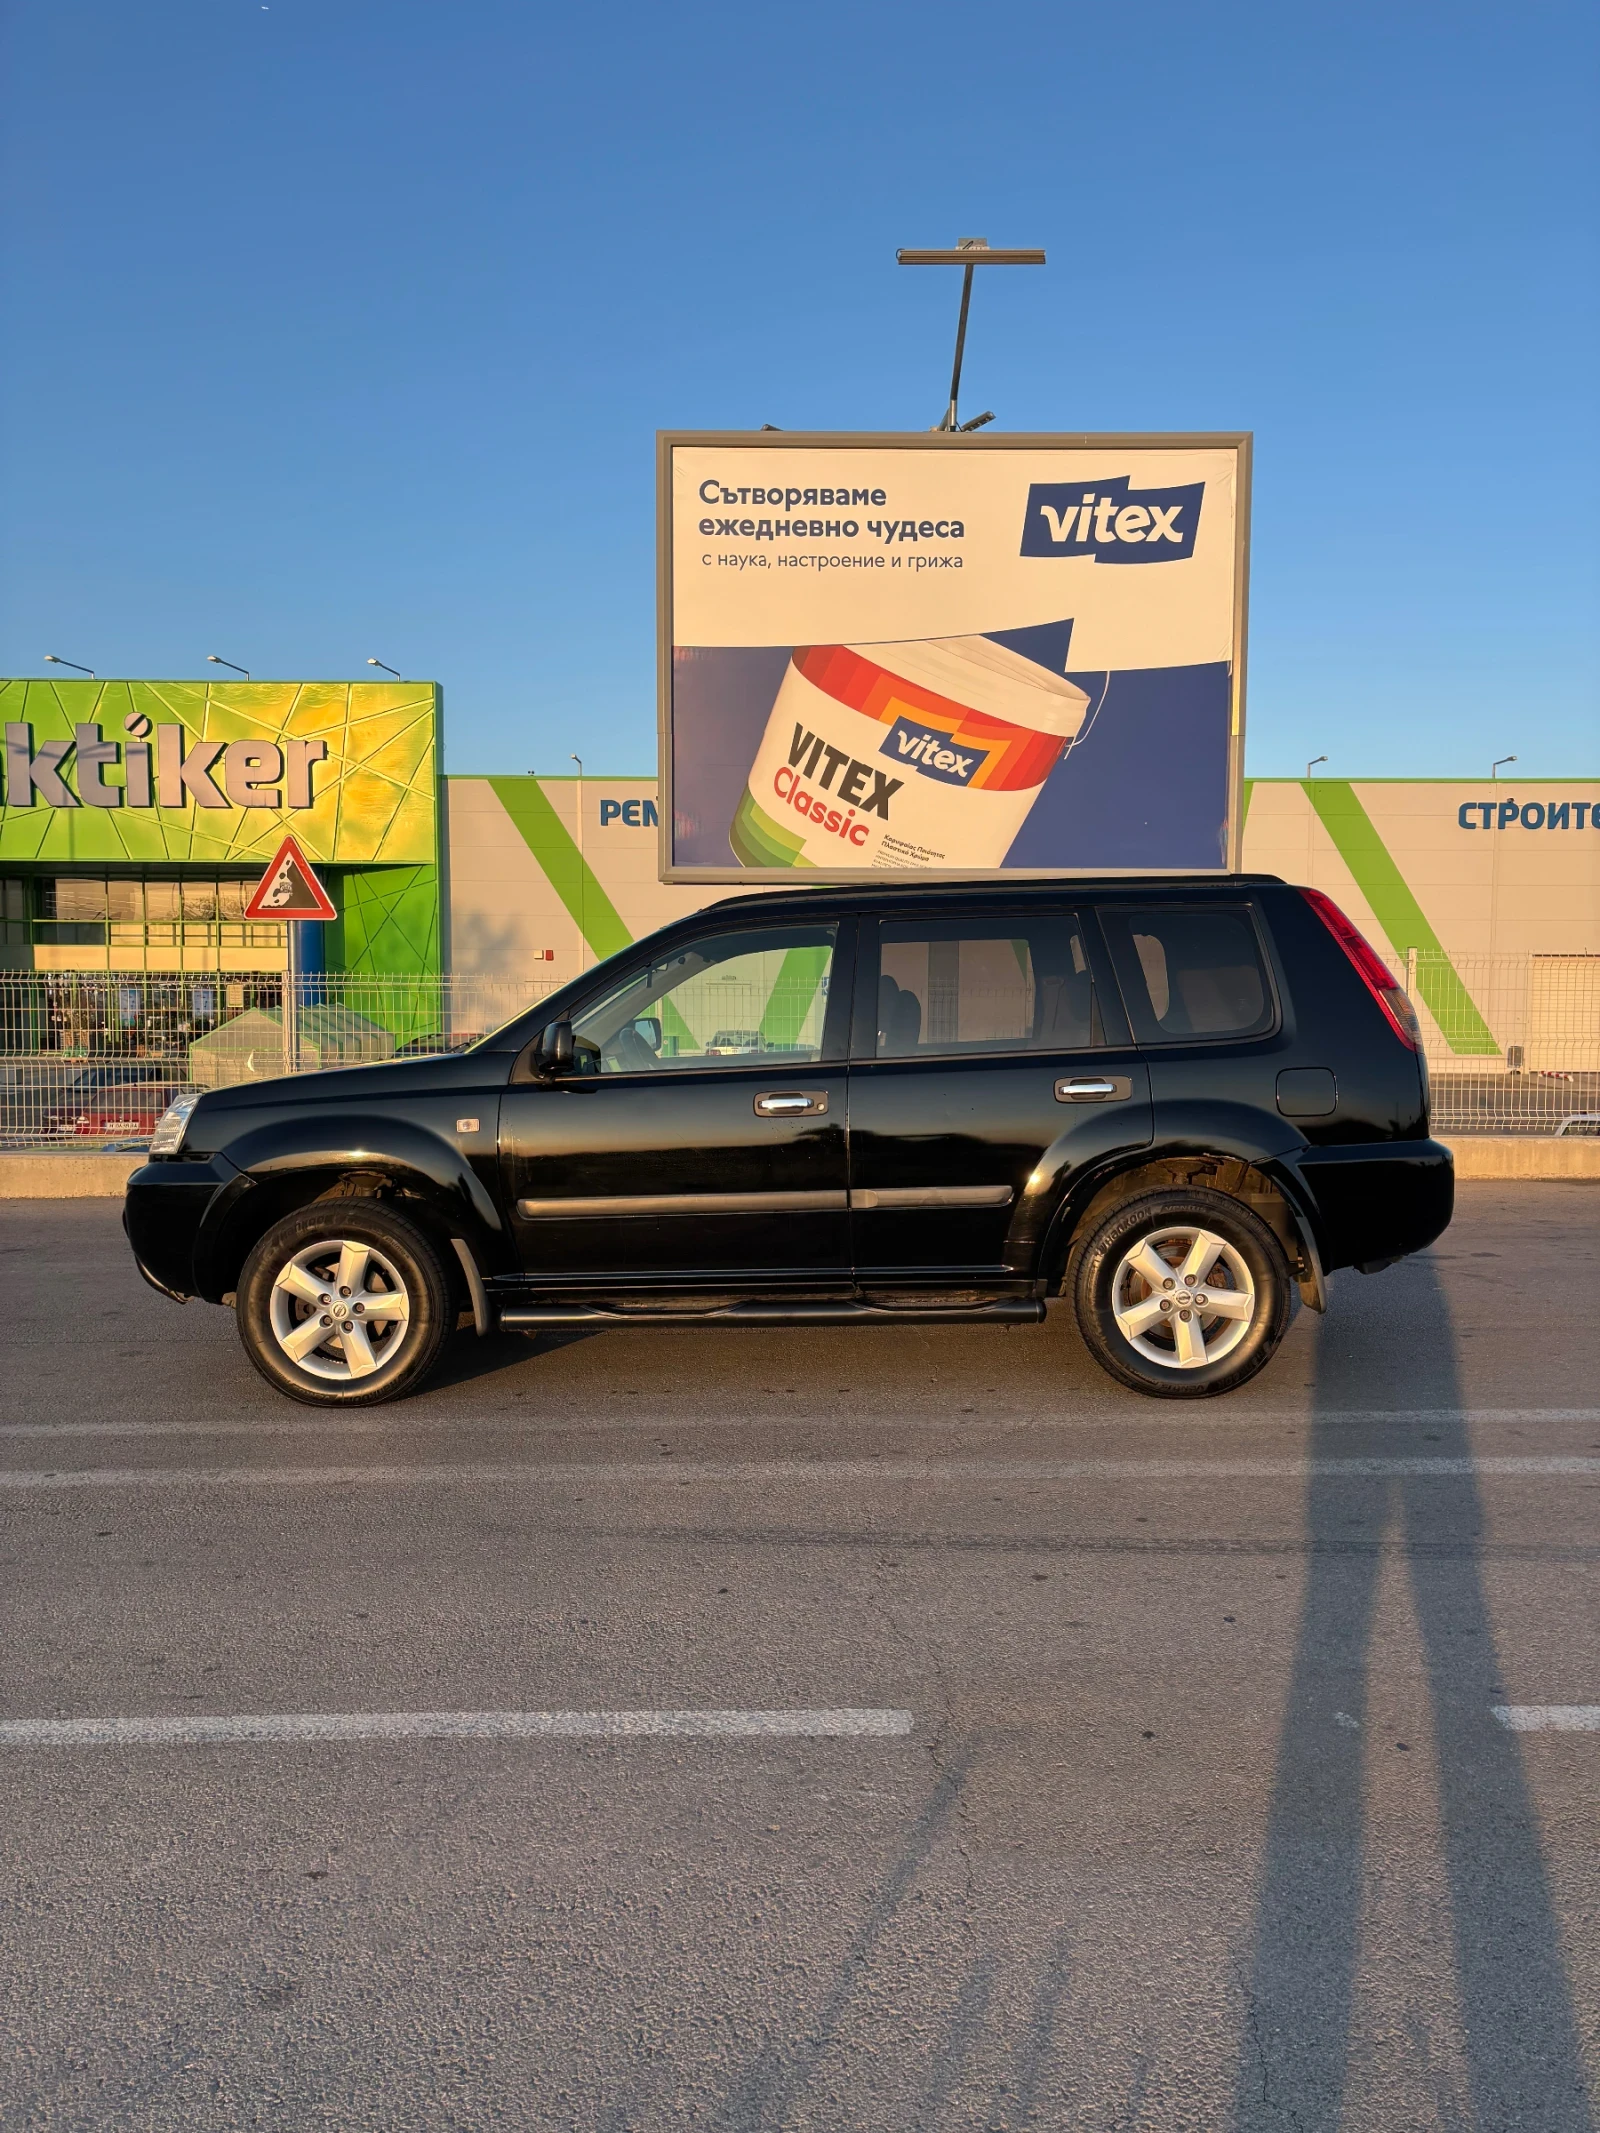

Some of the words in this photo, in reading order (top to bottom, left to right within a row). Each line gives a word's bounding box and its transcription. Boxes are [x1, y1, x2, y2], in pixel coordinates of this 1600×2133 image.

[699, 479, 887, 512] Сътворяваме
[1040, 493, 1184, 543] vitex
[699, 518, 860, 541] ежедневно
[867, 520, 965, 544] чудеса
[702, 554, 712, 566] с
[718, 554, 771, 571] наука,
[778, 555, 886, 572] настроение
[891, 555, 902, 568] и
[908, 555, 963, 572] грижа
[5, 712, 328, 809] ktiker
[788, 722, 905, 821] VITEX
[897, 730, 974, 778] vitex
[773, 766, 870, 846] Classic
